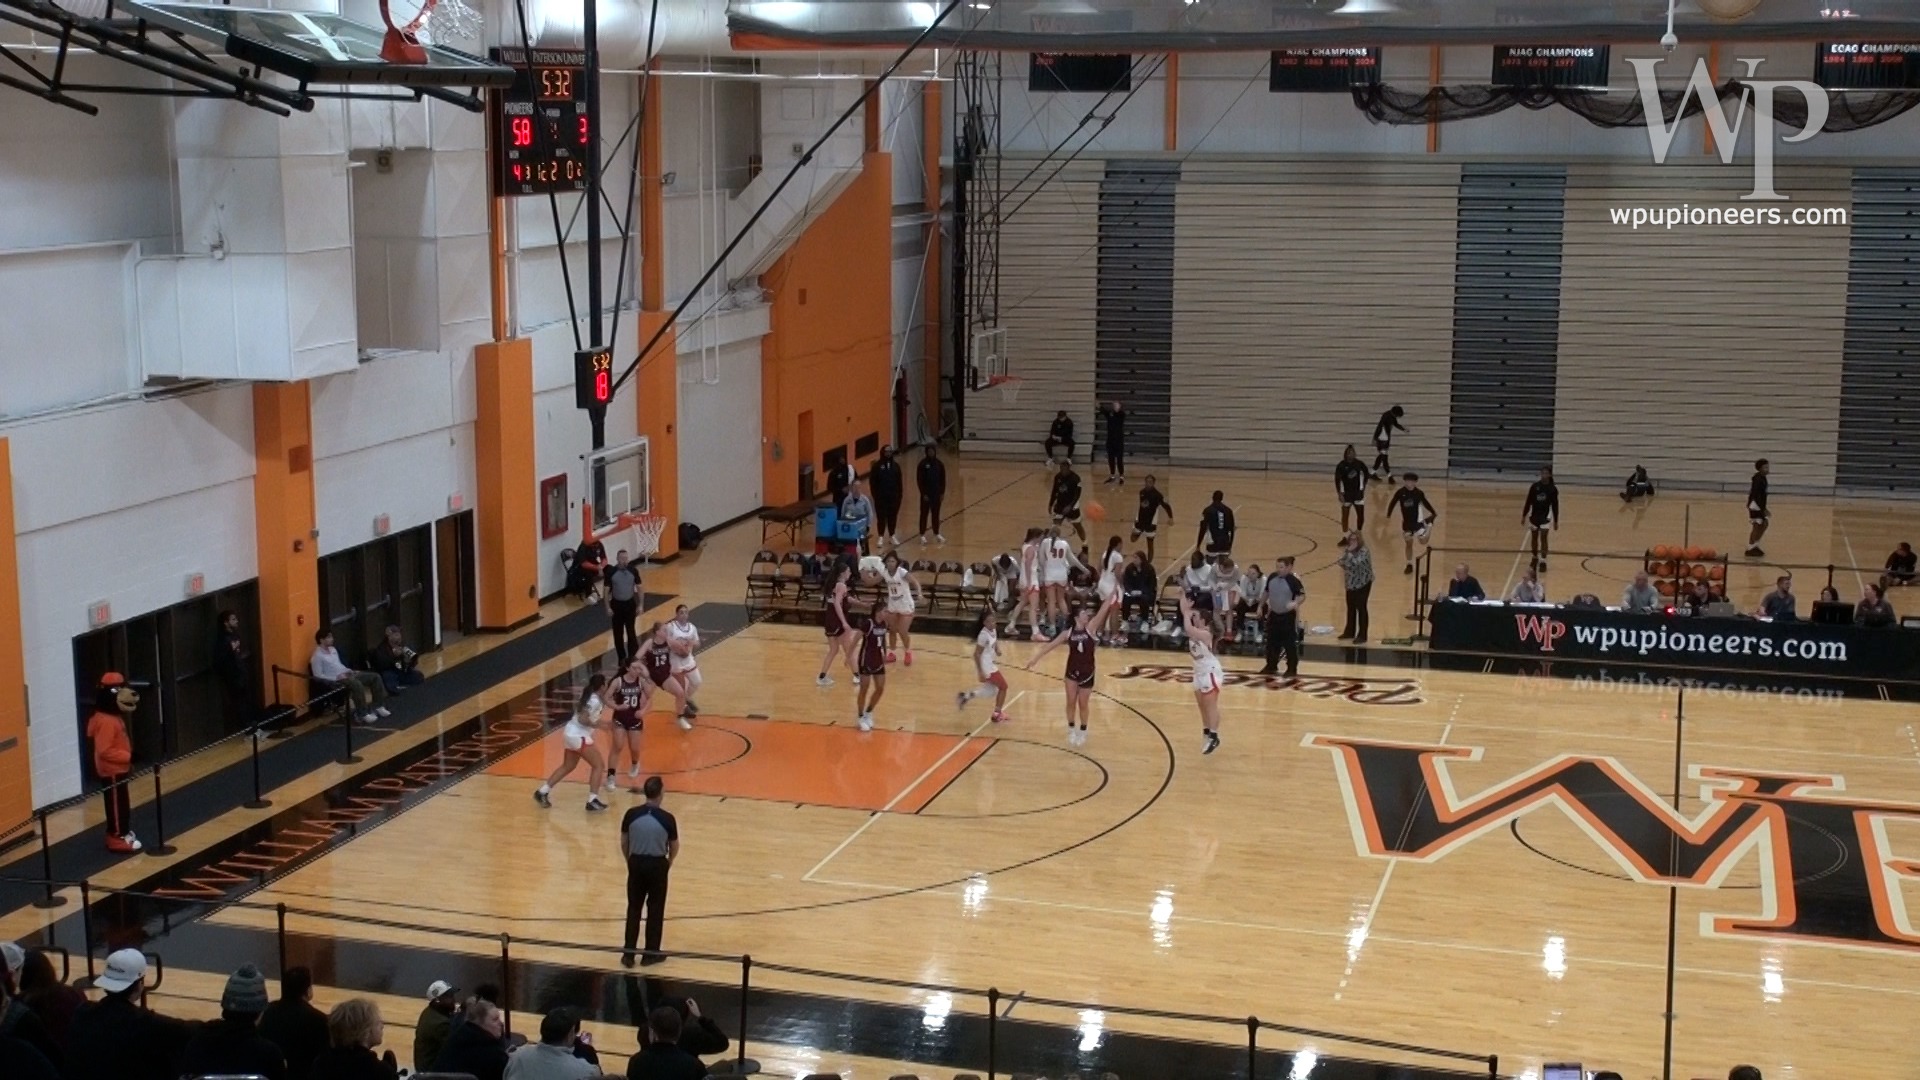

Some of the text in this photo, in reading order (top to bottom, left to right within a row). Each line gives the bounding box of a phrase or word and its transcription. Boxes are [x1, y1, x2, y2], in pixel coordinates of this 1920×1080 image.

[1311, 47, 1368, 56] CHAMPIONS
[1536, 48, 1595, 57] CHAMPIONS
[1861, 44, 1920, 53] CHAMPION
[503, 50, 530, 63] WILLIA
[512, 118, 531, 146] 58
[1515, 614, 1848, 661] WP wpupioneers.com
[623, 696, 638, 708] 20
[152, 706, 573, 896] WILLIAM PATERSON
